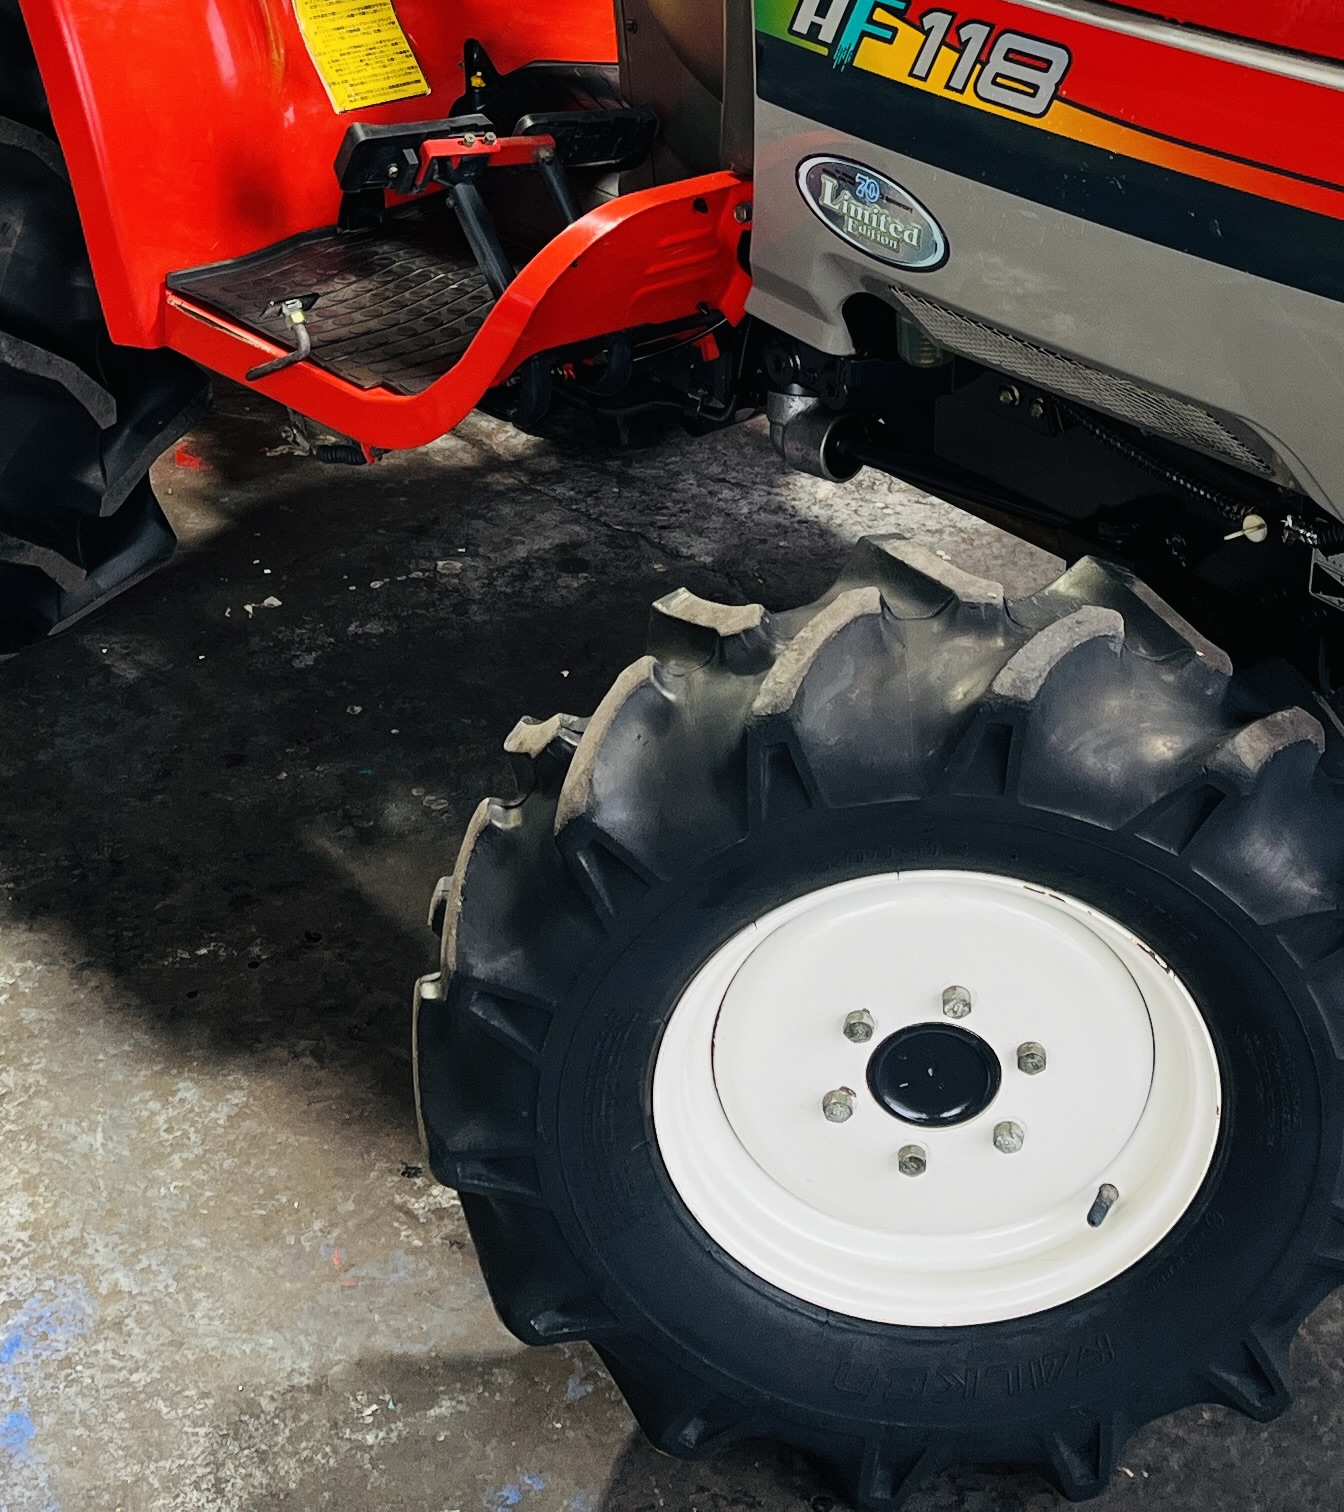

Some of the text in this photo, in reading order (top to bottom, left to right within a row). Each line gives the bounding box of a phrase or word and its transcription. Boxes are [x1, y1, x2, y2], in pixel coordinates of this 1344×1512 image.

[855, 173, 880, 203] 70
[819, 173, 923, 250] Limited
[843, 216, 900, 254] Edition
